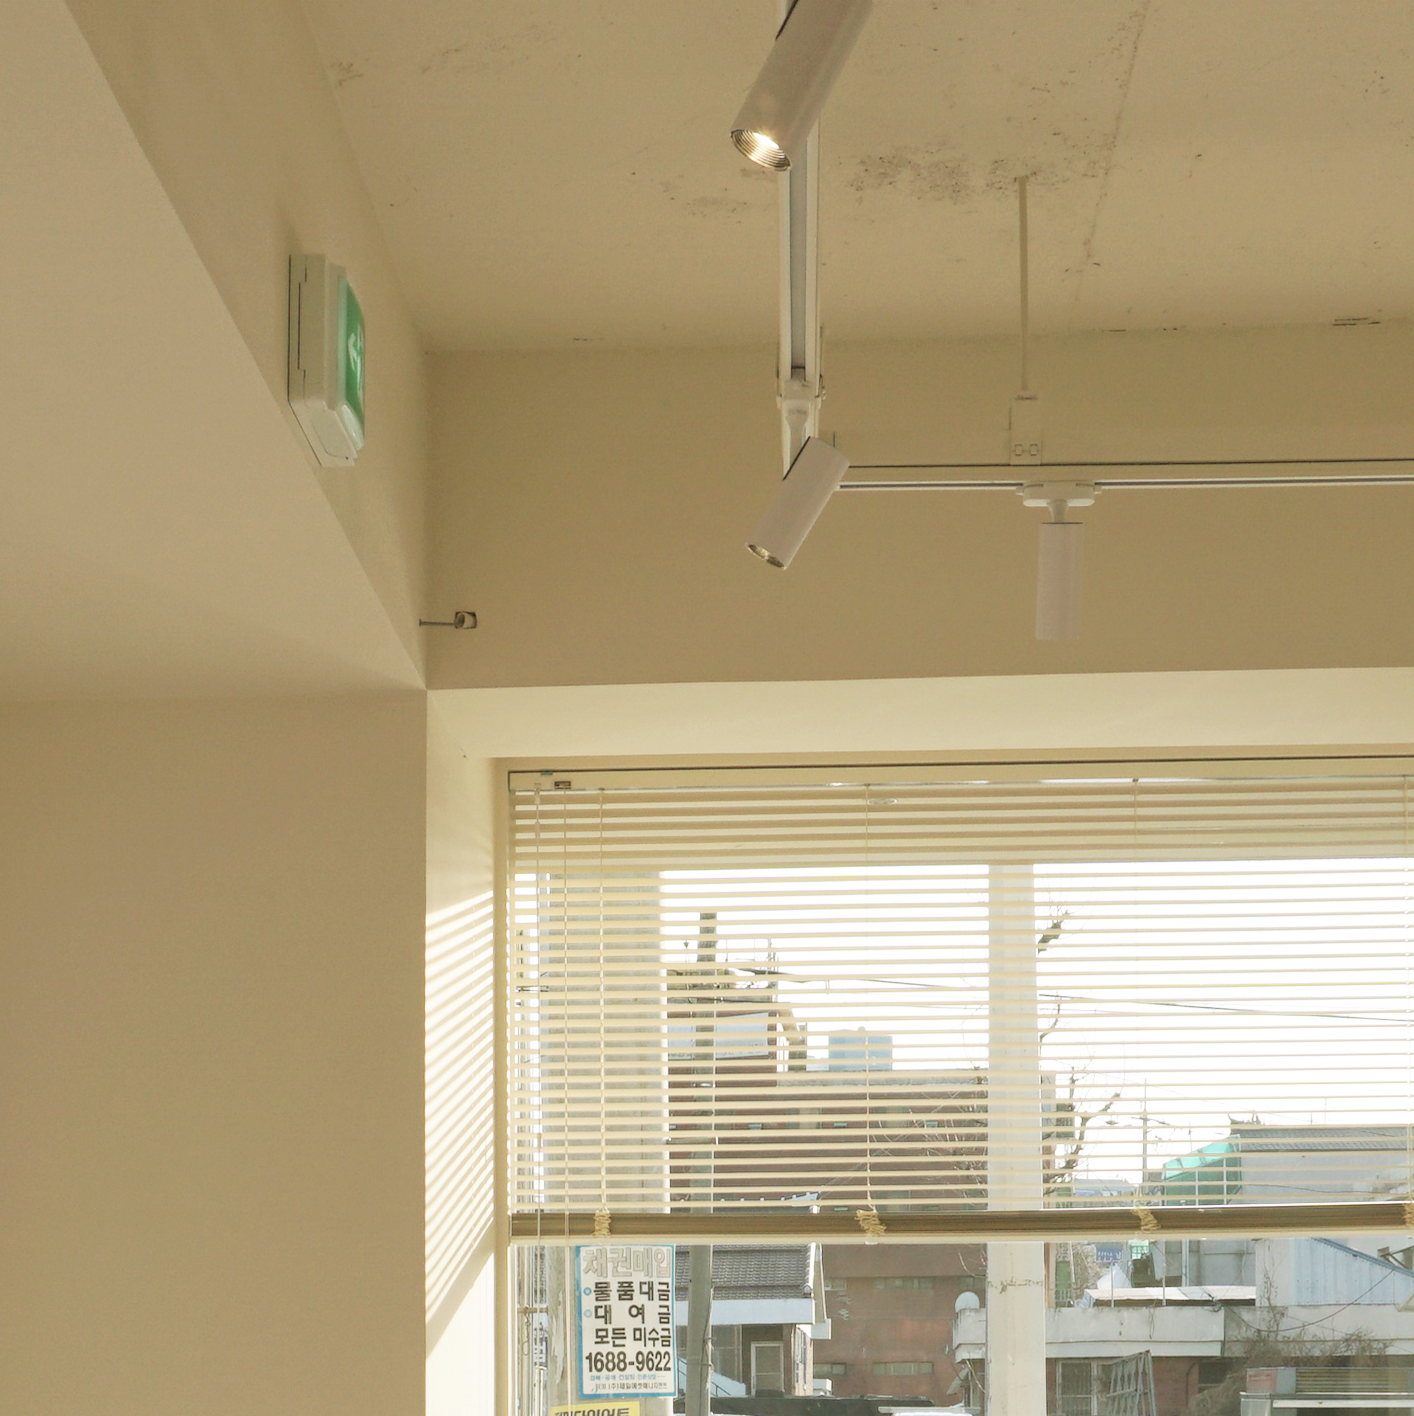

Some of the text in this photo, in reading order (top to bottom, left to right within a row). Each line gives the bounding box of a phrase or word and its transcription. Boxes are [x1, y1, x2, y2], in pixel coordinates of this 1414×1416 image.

[582, 1247, 671, 1278] 채권매입
[594, 1327, 671, 1347] 모든 미수금
[585, 1350, 671, 1372] 1688-9622
